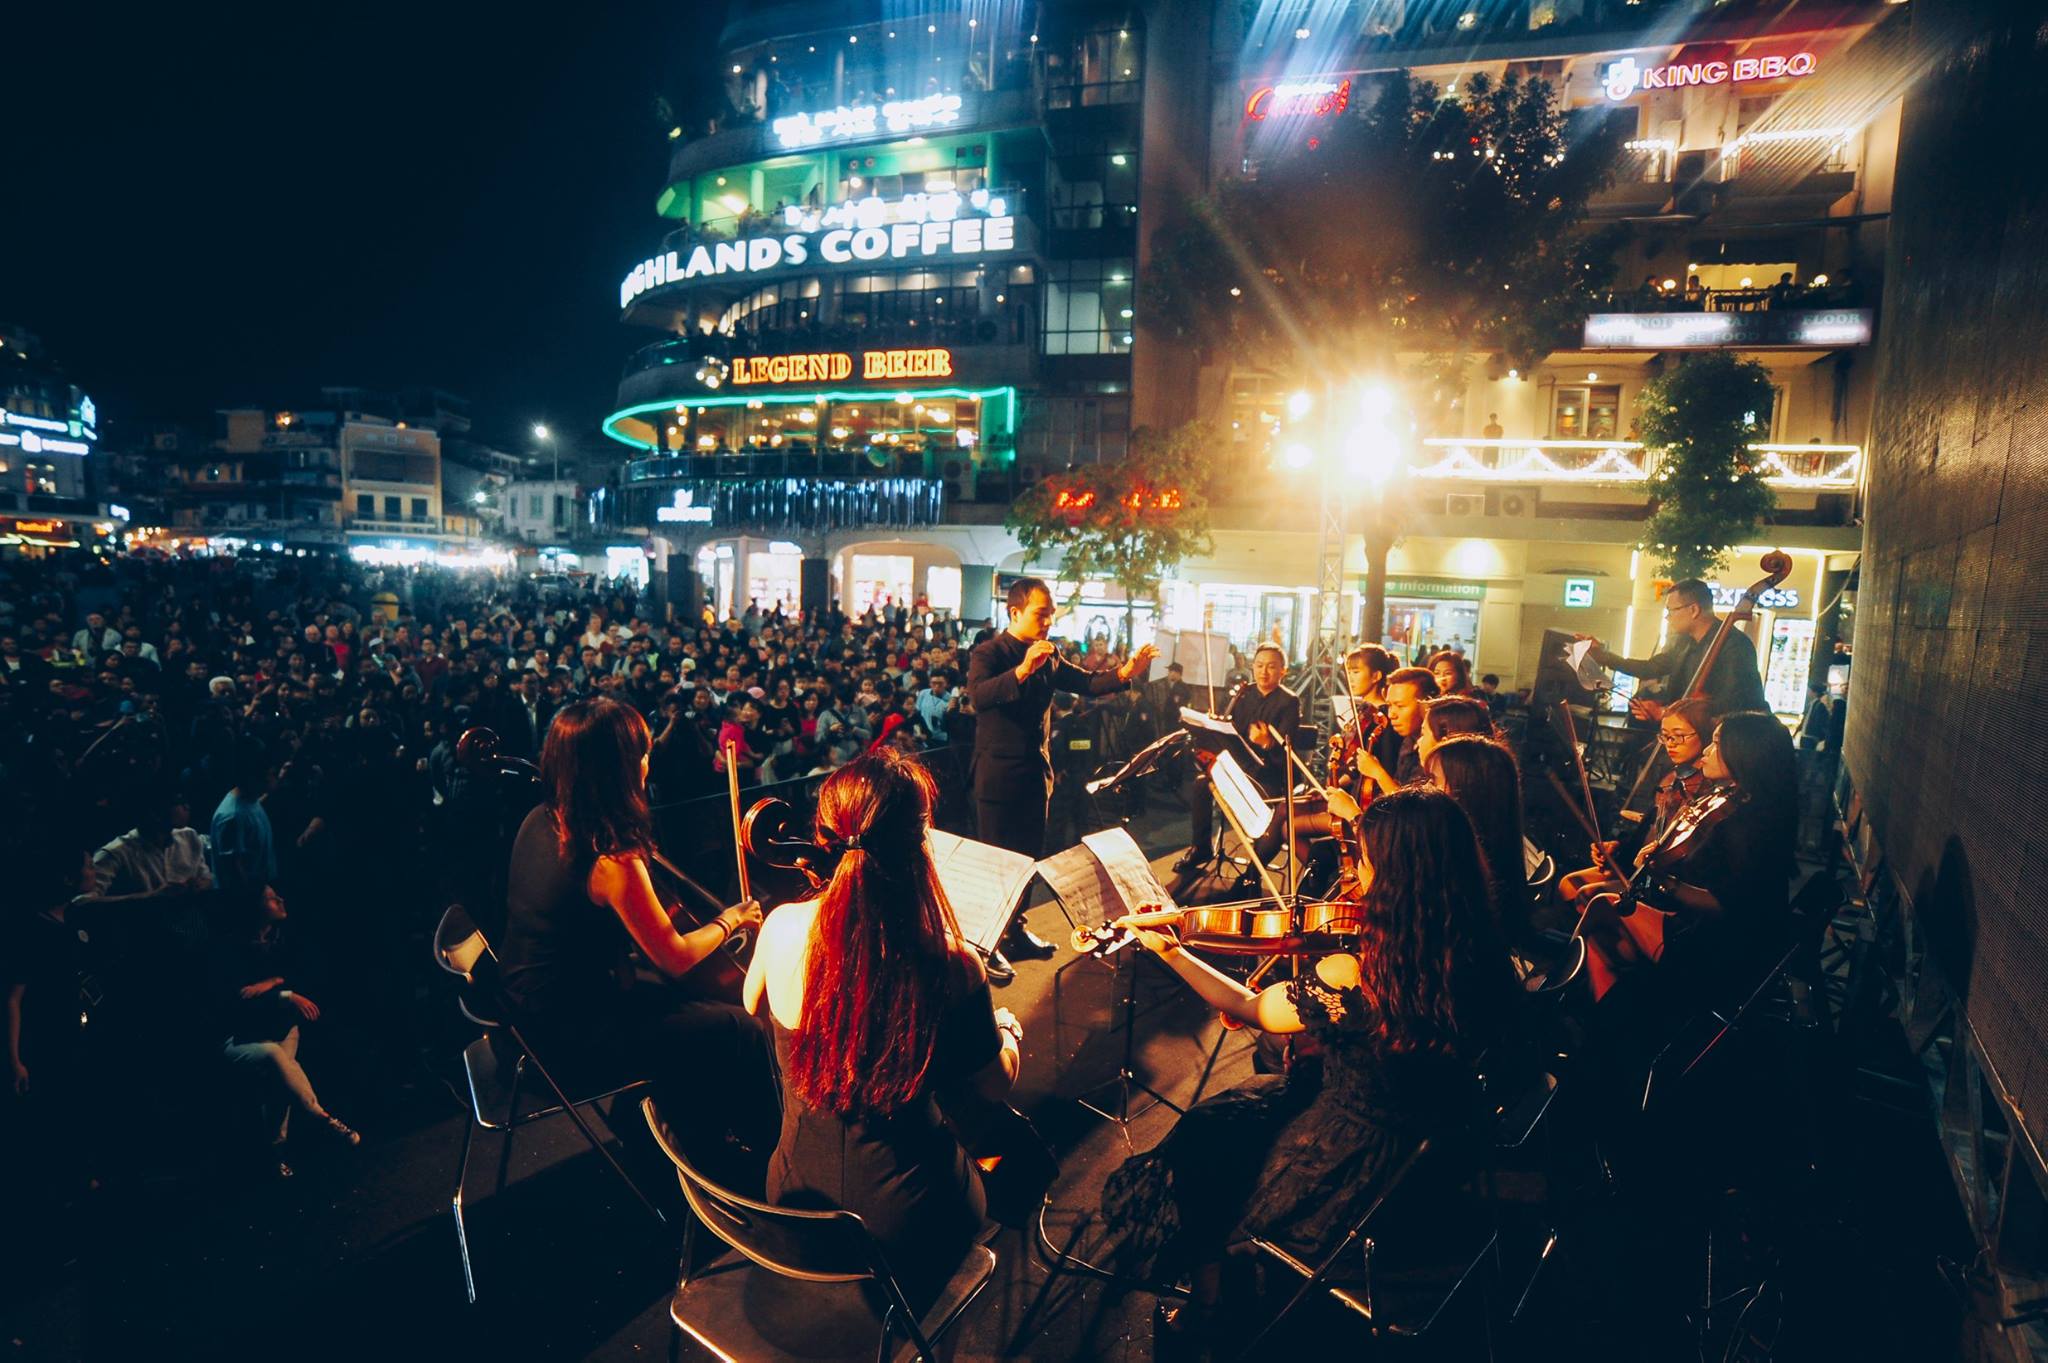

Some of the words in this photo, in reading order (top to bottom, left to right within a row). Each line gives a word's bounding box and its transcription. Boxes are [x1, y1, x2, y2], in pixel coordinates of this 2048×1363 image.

[1643, 61, 1728, 89] KING
[1732, 53, 1817, 82] BBQ
[820, 216, 1014, 263] COFFEE
[732, 353, 852, 385] LEGEND
[863, 349, 952, 380] BEER
[1707, 583, 1799, 607] Expess
